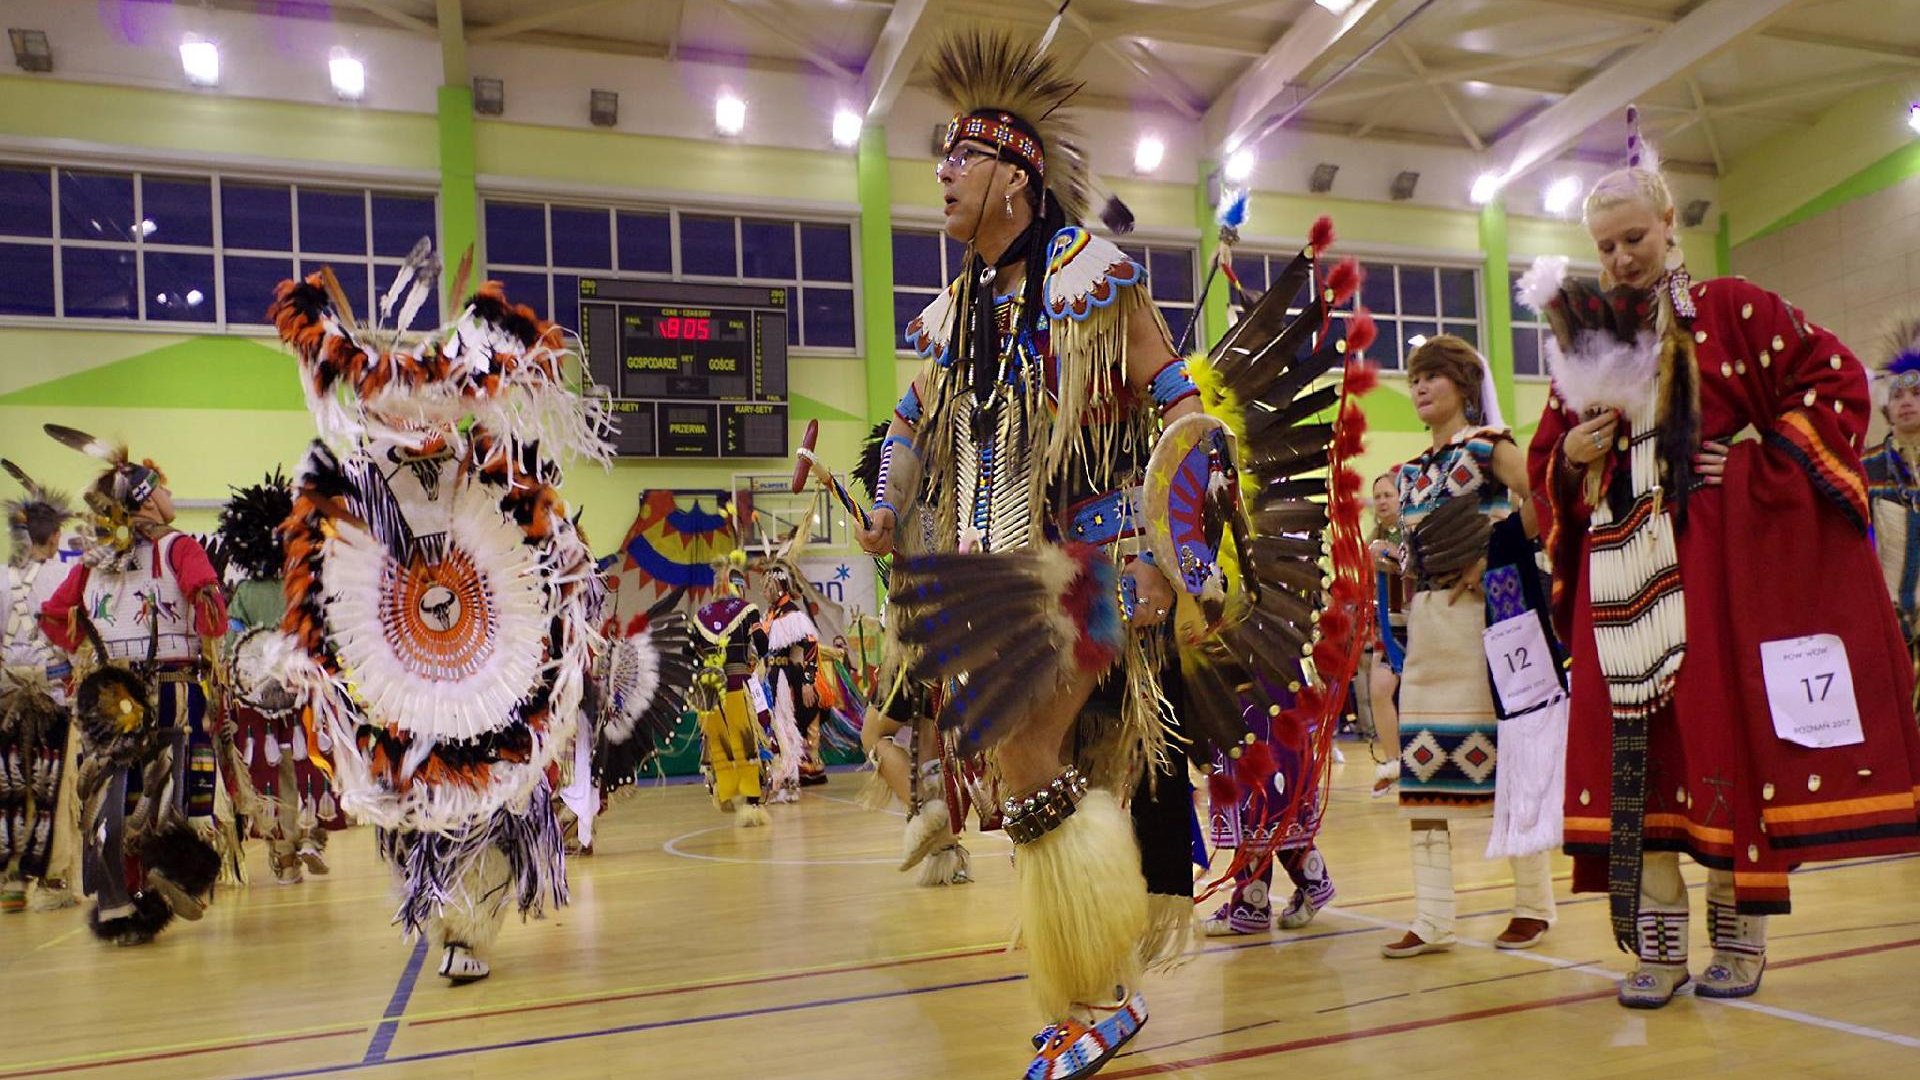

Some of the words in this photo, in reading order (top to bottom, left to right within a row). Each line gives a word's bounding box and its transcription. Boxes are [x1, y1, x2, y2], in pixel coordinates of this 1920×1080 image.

[627, 357, 678, 369] GOSPODARZE
[709, 357, 736, 370] GOŚCIE
[670, 424, 707, 434] PRZERWA
[1503, 647, 1532, 673] 12
[1800, 672, 1834, 703] 17
